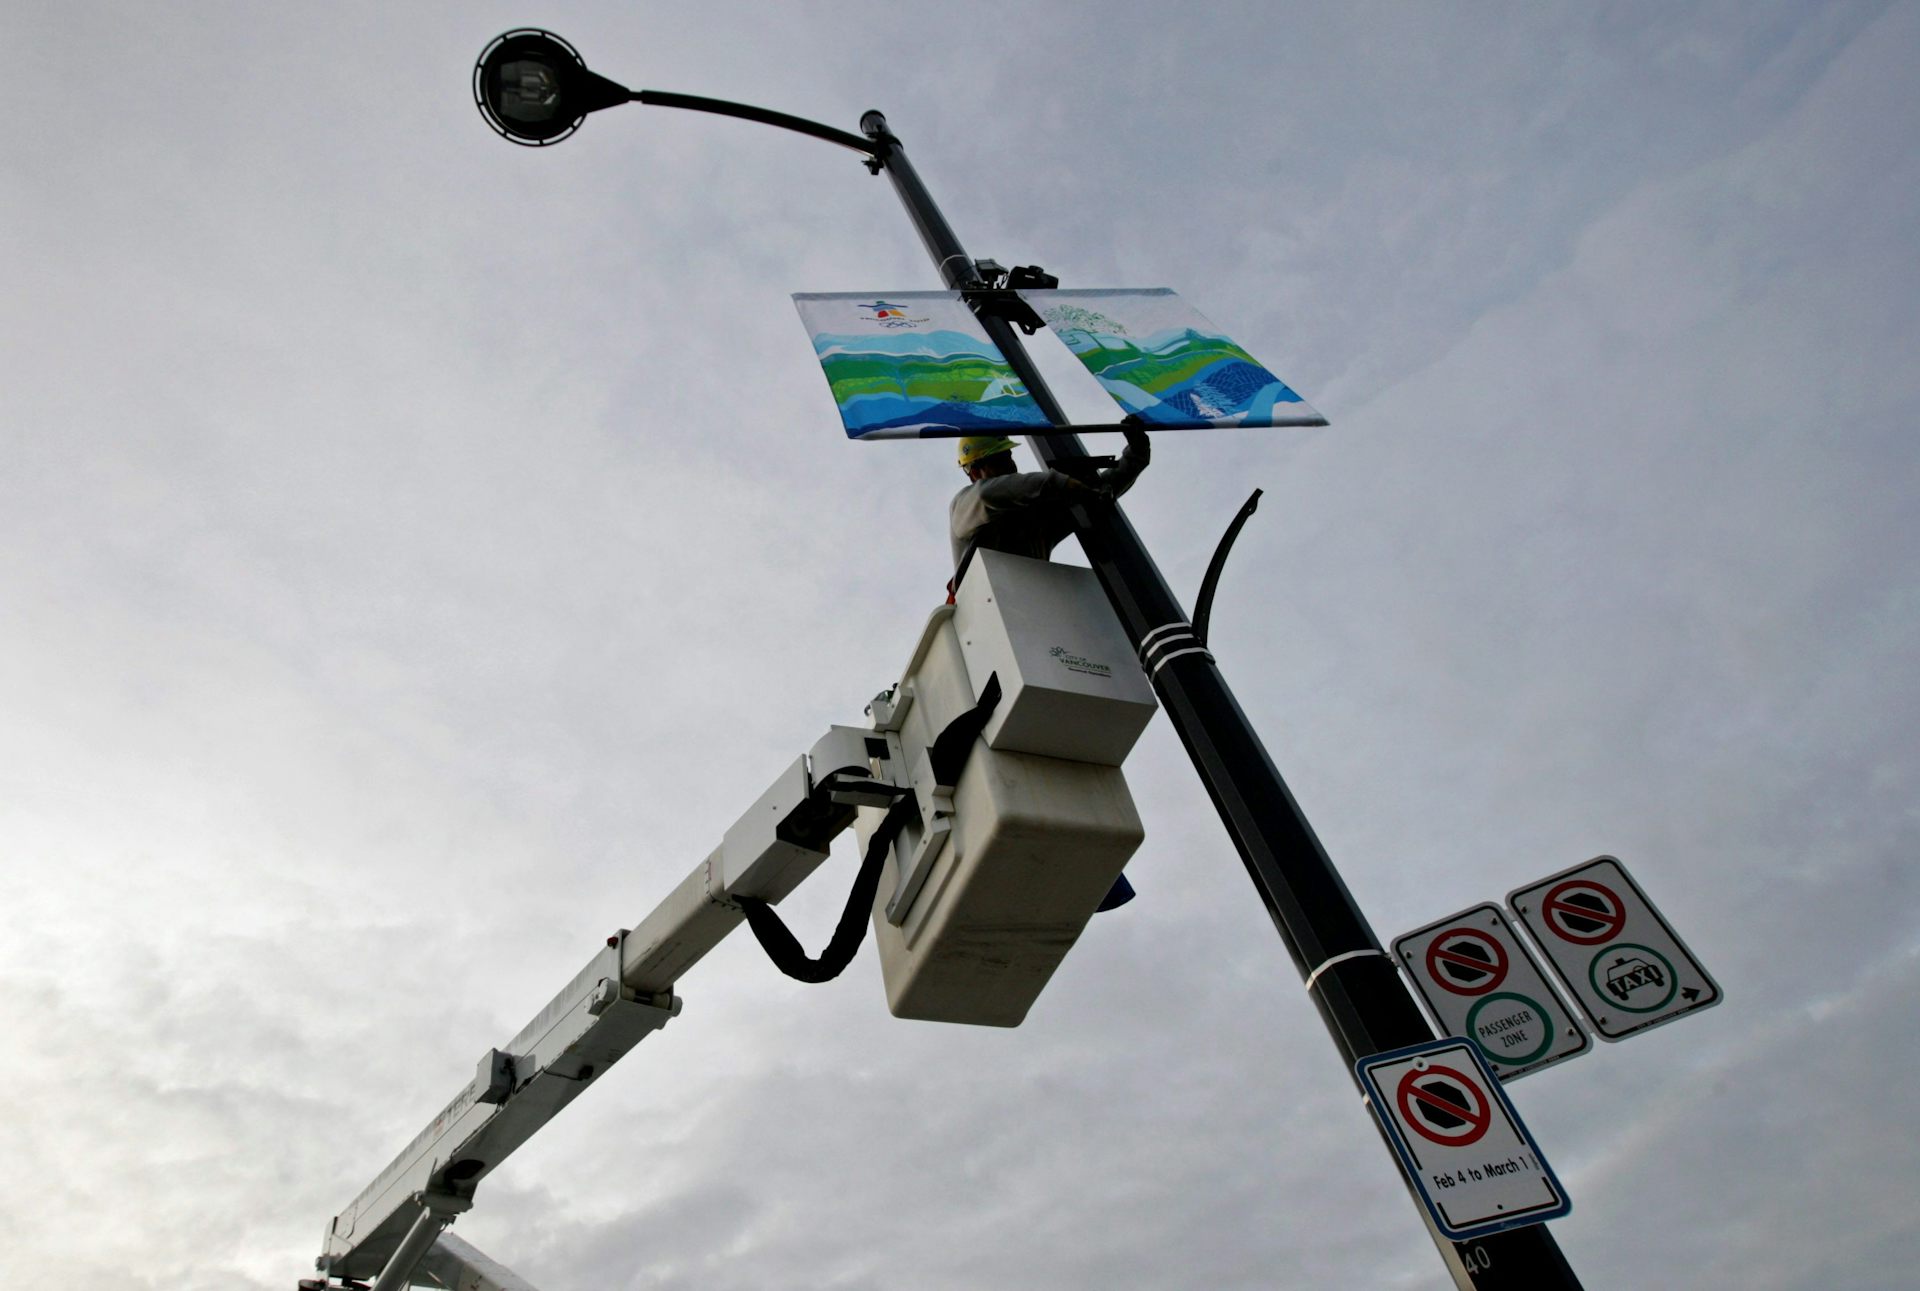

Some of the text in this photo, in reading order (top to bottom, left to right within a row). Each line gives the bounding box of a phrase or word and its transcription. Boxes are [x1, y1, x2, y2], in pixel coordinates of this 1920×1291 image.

[1059, 658, 1111, 671] VANCOUVER
[1609, 966, 1660, 993] TAXI
[1478, 1010, 1533, 1038] PASSENGER
[1500, 1030, 1528, 1048] ZONE
[446, 1083, 476, 1122] TERE
[1433, 1173, 1455, 1189] Feb
[1457, 1170, 1467, 1184] 4
[1467, 1168, 1482, 1182] to
[1483, 1158, 1519, 1178] March
[1519, 1156, 1529, 1170] 1
[1465, 1245, 1491, 1275] 40
